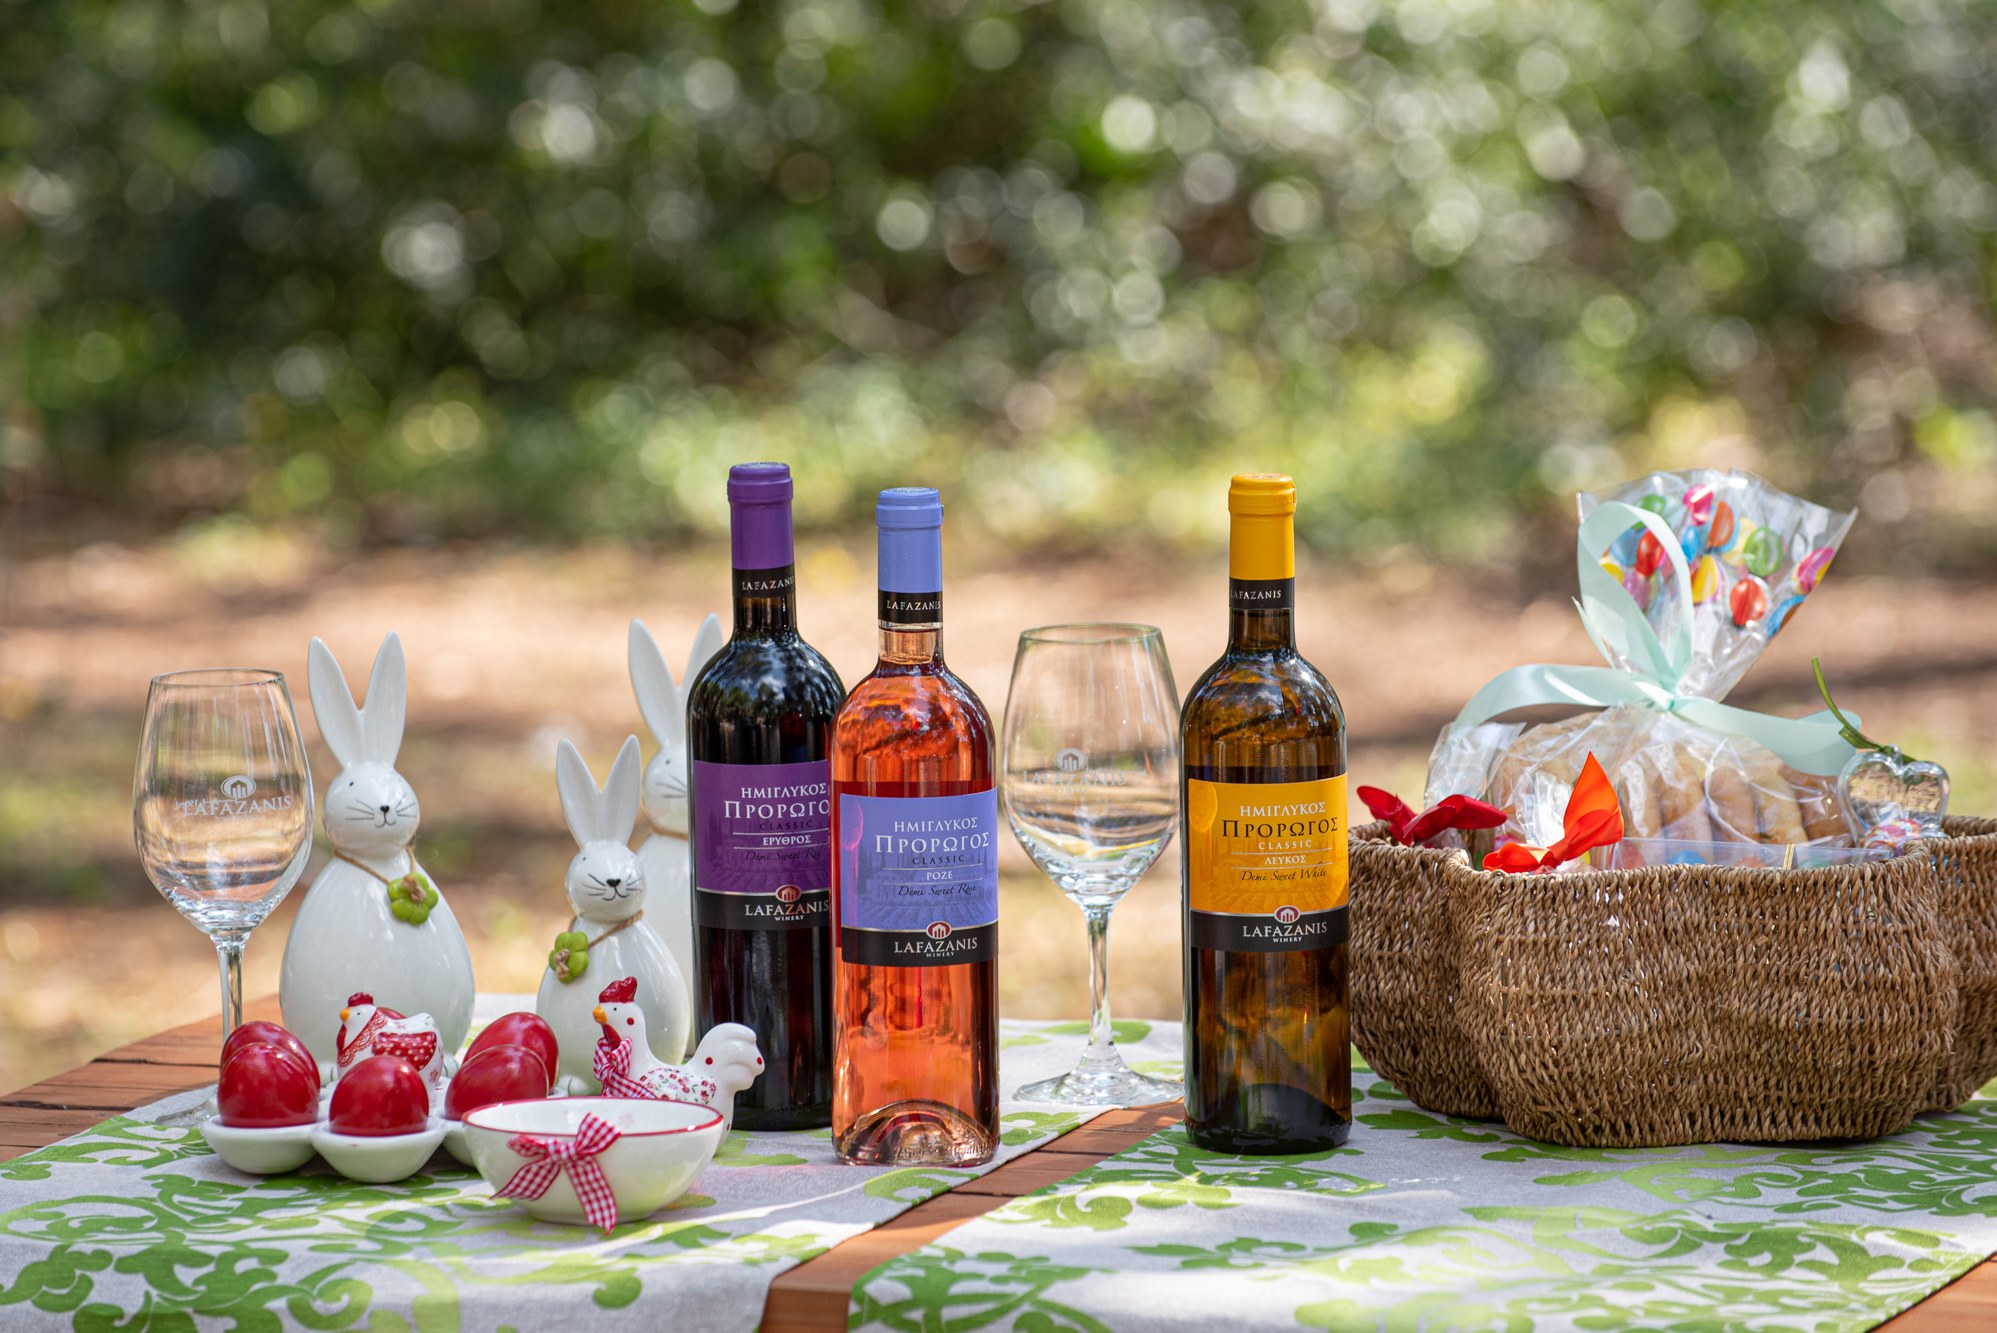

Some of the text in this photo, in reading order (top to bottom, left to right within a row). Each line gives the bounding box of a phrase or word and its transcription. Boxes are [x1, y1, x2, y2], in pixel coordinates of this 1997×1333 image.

[1230, 589, 1282, 600] LAFAZANIS
[887, 601, 941, 611] LAFAZANIS
[741, 783, 826, 799] ΗΜΙΓΛΥΚΟΣ
[183, 795, 292, 817] LAFAZANIS
[724, 800, 829, 819] ΠΡΟΡΩΓΟ
[1239, 801, 1326, 817] ΗΜΙΓΛΥΚΟΣ
[759, 820, 814, 830] CLASSIC
[894, 816, 978, 832] ΗΜΙΓΛΥΚΟΣ
[1222, 817, 1338, 838] ΠΡΟΡΩΓΟΣ
[762, 835, 811, 846] ΕΡΥΘΡΟΣ
[875, 832, 989, 853] ΠΡΟΡΩΓΟΣ
[1258, 839, 1312, 850] CLASSIC
[745, 850, 771, 861] Demi
[775, 849, 801, 861] Sweet
[912, 855, 965, 865] CLASSIC
[1264, 855, 1307, 865] ΛΕΥΚΟΣ
[1241, 861, 1328, 881] Demi Sweet White
[898, 885, 926, 896] Demi
[928, 885, 954, 896] Sweet
[745, 900, 829, 916] LAFAZANIS
[1242, 921, 1328, 938] LAFAZANIS
[894, 937, 978, 953] LAFAZANIS
